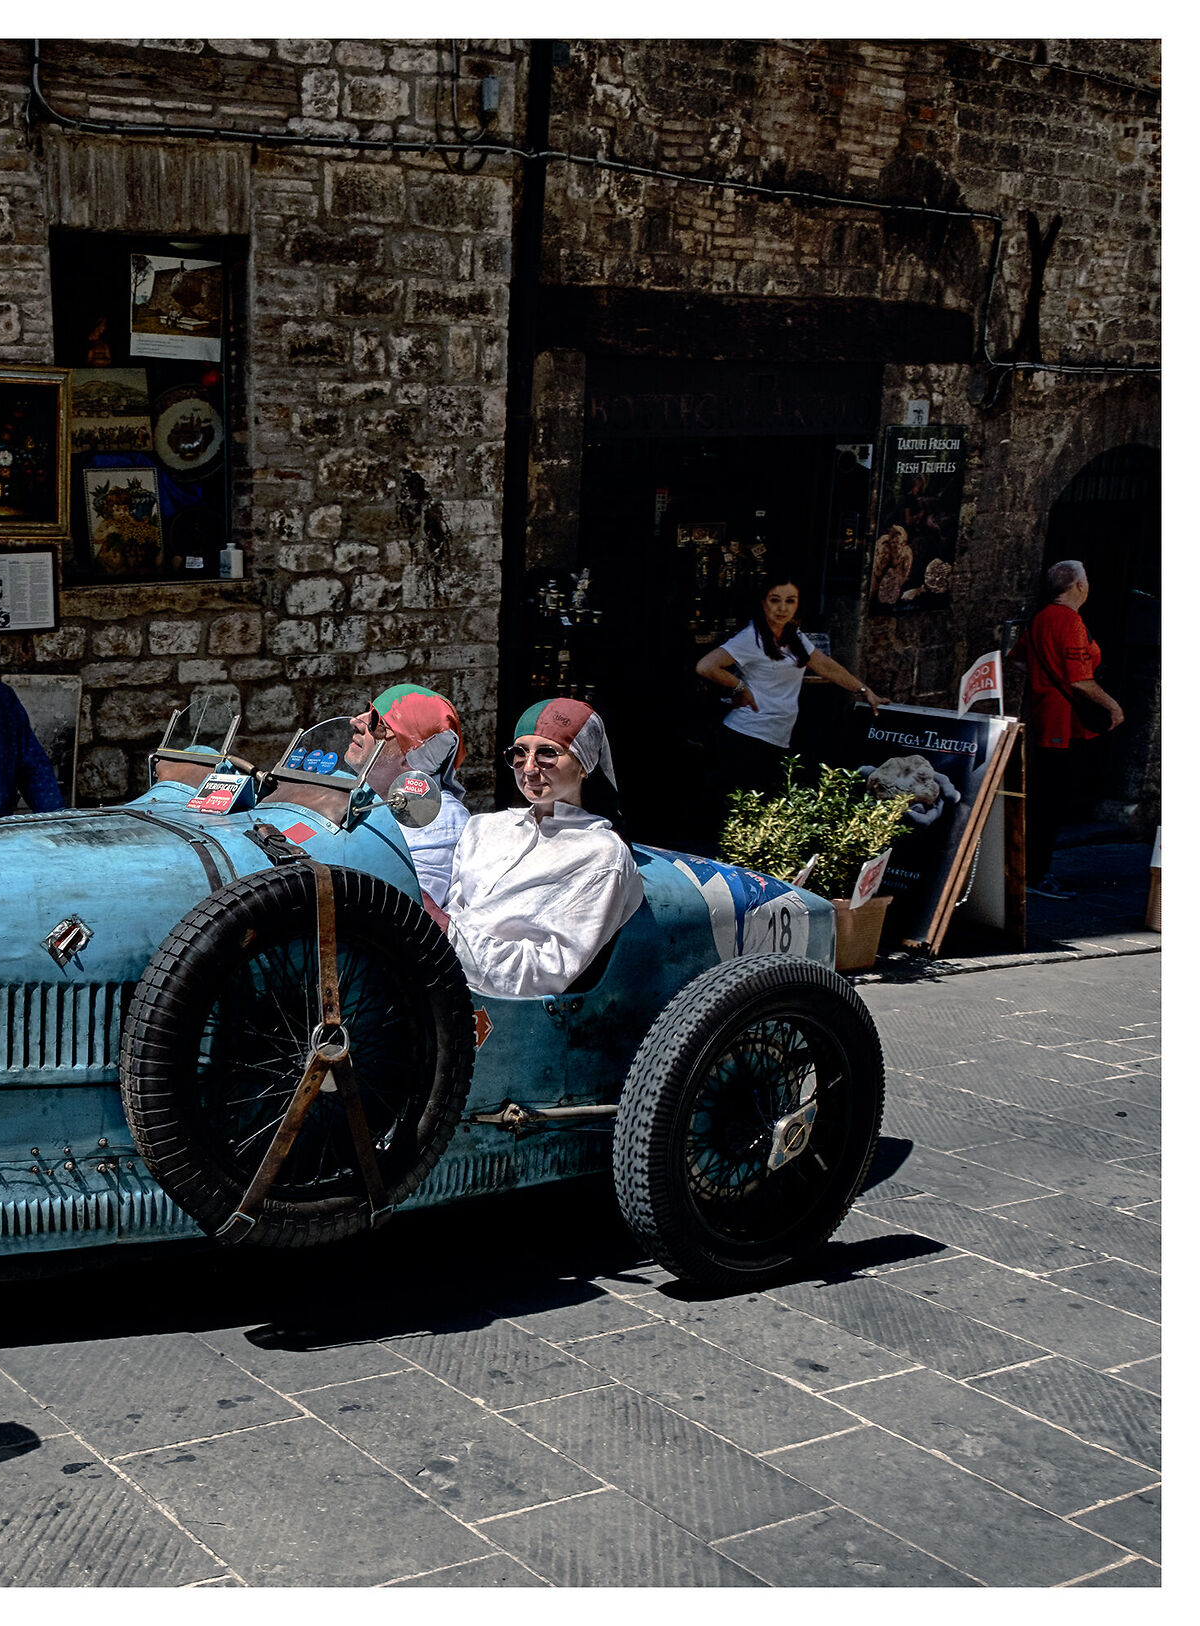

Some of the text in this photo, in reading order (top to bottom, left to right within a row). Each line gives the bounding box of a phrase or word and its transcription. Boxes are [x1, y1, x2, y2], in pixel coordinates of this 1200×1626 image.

[897, 437, 961, 450] TARTUFI FRESCHI
[896, 461, 956, 473] FRESH TRUFFLES
[868, 727, 978, 753] BOTTEGA TARTUFO
[405, 785, 423, 793] MIGLIA
[768, 907, 792, 953] 18
